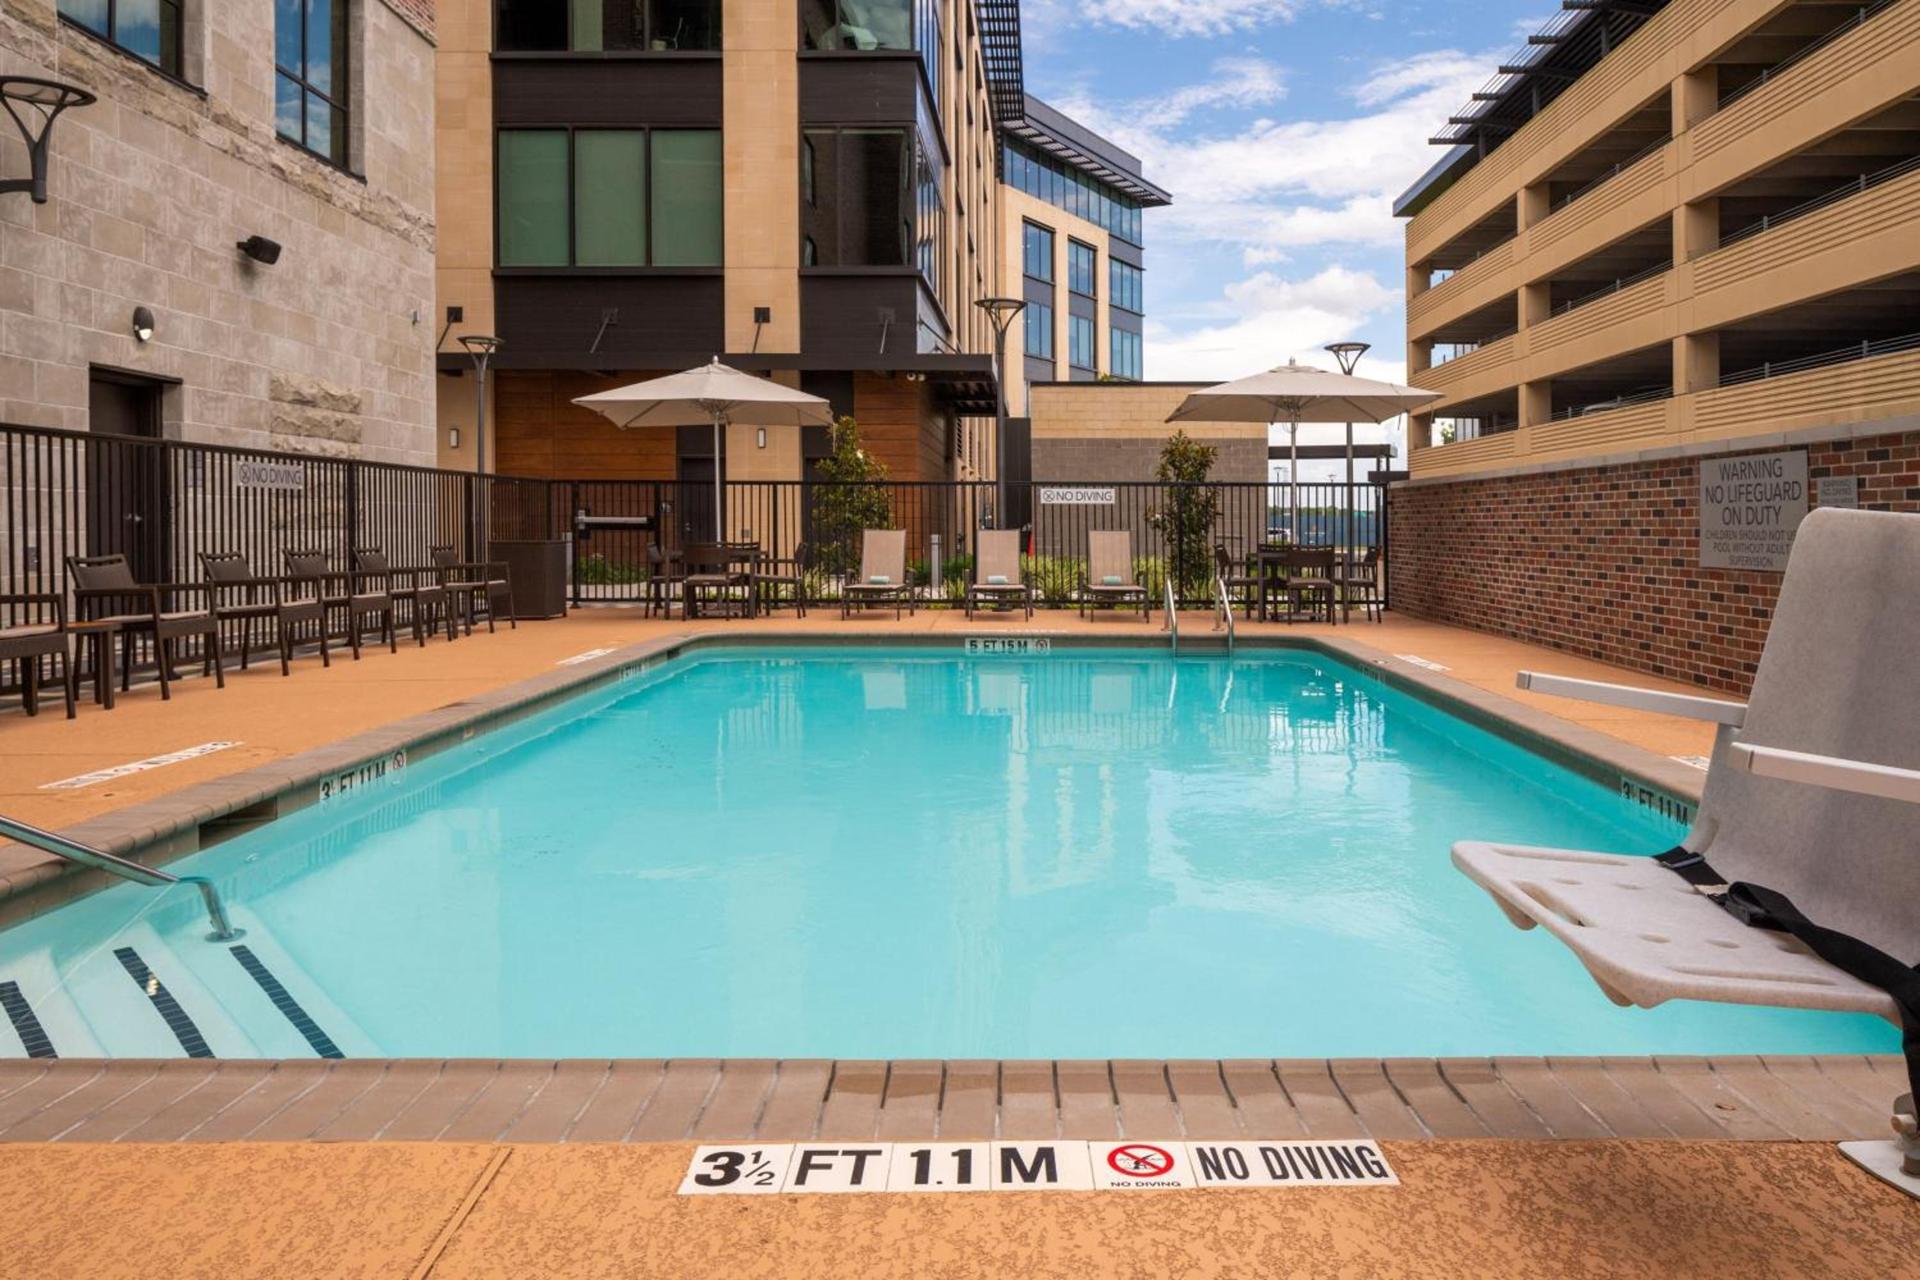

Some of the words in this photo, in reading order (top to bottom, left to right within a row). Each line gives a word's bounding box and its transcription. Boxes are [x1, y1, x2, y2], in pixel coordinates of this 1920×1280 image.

[252, 467, 268, 483] NO
[270, 469, 302, 485] DIVING
[1719, 458, 1783, 481] WARNING
[1056, 491, 1074, 501] NO
[1075, 491, 1113, 501] DIVING
[1705, 486, 1724, 504] NO
[1727, 481, 1802, 503] LIFEGUARD
[1722, 506, 1741, 525] ON
[1746, 505, 1782, 525] DUTY
[1706, 530, 1737, 540] CHILDREN
[1739, 531, 1766, 541] SHOULD
[1769, 531, 1785, 541] NOT
[1713, 542, 1732, 553] POOL
[1735, 542, 1764, 553] WITHOUT
[1728, 554, 1774, 567] SUPERVISION
[794, 1149, 883, 1186] FT
[910, 1148, 973, 1185] 1.1
[1000, 1147, 1058, 1184] M
[1196, 1147, 1250, 1181] NO
[1258, 1145, 1390, 1180] DIVING
